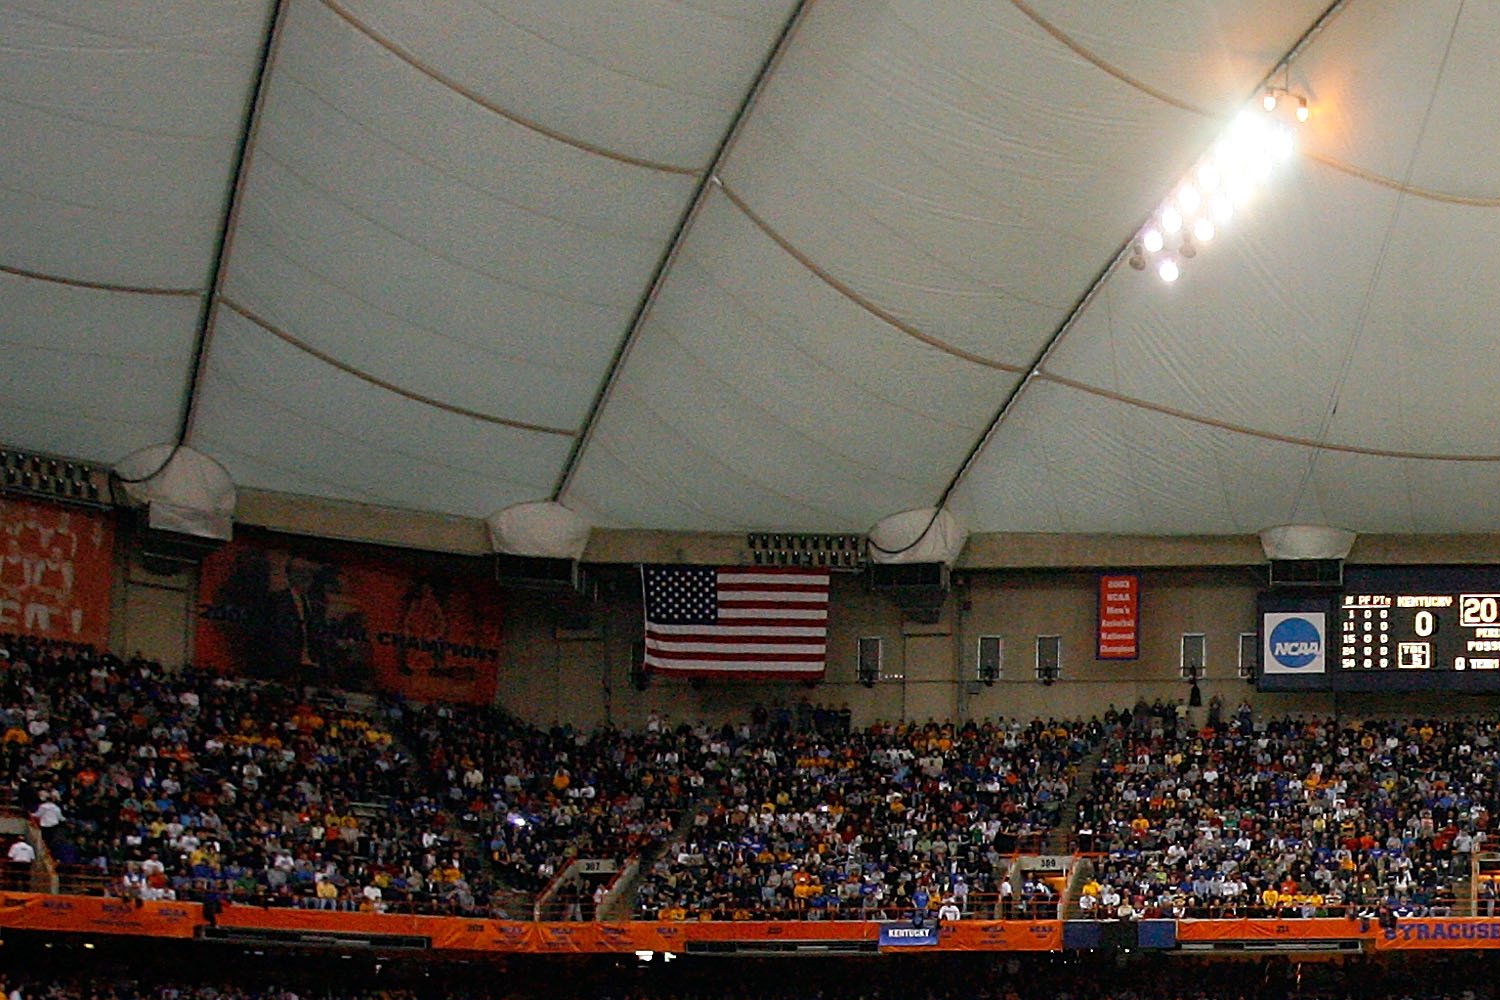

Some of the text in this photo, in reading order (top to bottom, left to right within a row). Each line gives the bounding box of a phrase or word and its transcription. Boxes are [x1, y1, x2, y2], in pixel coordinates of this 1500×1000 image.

[1397, 596, 1453, 607] KENTUCKY
[1343, 622, 1355, 632] 11
[1415, 611, 1434, 637] 0
[1274, 642, 1321, 656] NCAA
[1454, 657, 1466, 670] 0
[888, 928, 930, 938] KENTUCKY
[1384, 922, 1500, 939] SYRACUSE
